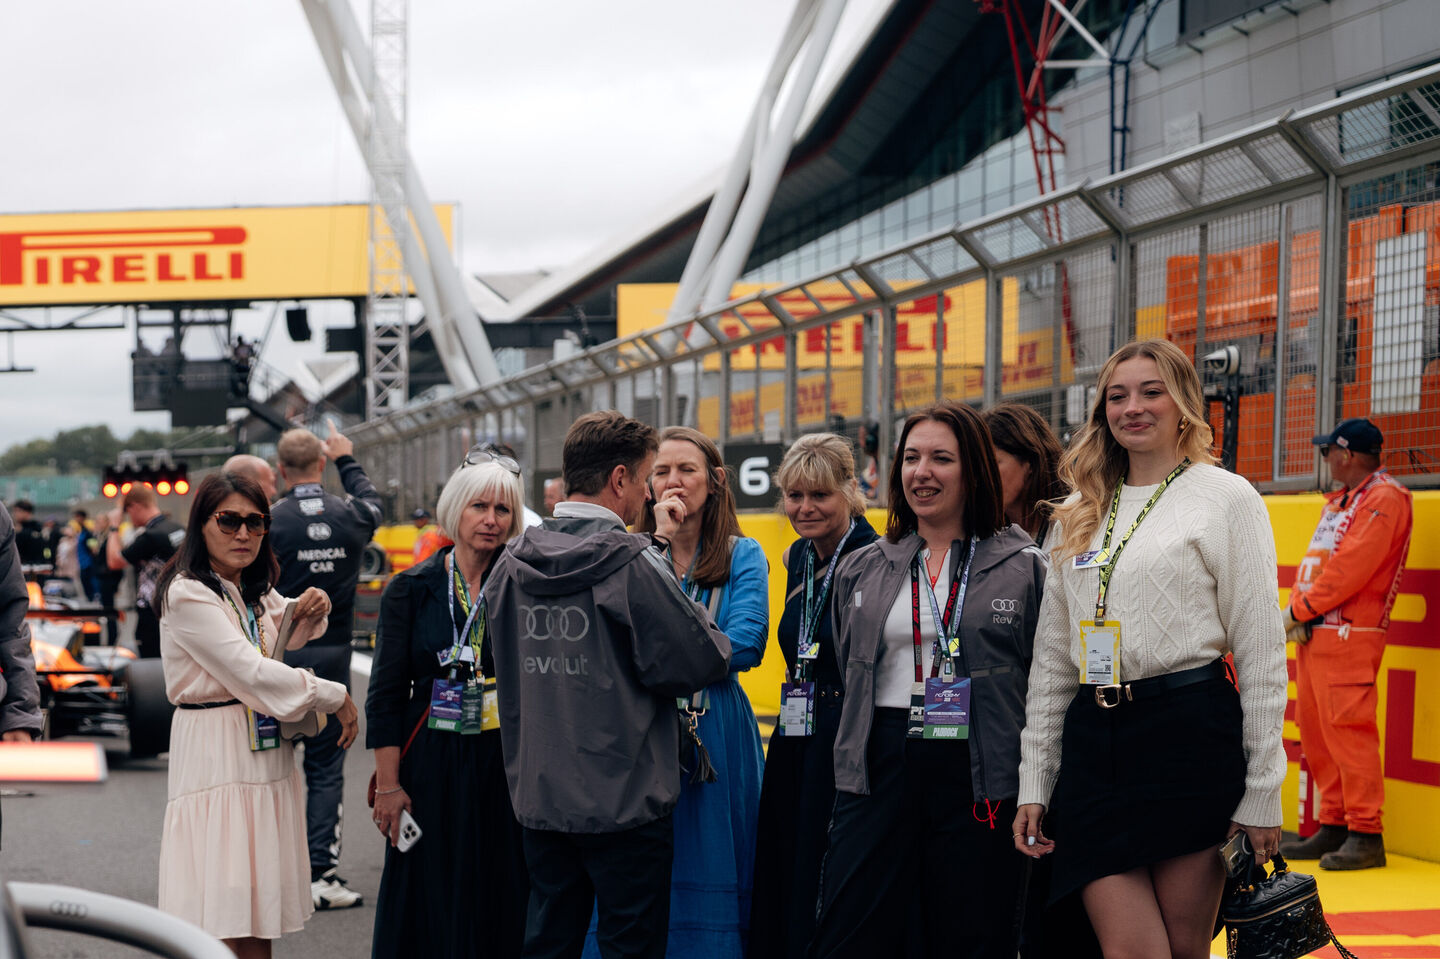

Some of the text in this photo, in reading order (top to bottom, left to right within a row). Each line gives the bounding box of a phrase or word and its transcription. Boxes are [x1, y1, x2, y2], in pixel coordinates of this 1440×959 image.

[739, 456, 770, 496] 6
[297, 547, 347, 561] MEDICAL
[309, 561, 335, 573] CAR
[522, 653, 589, 675] evolut
